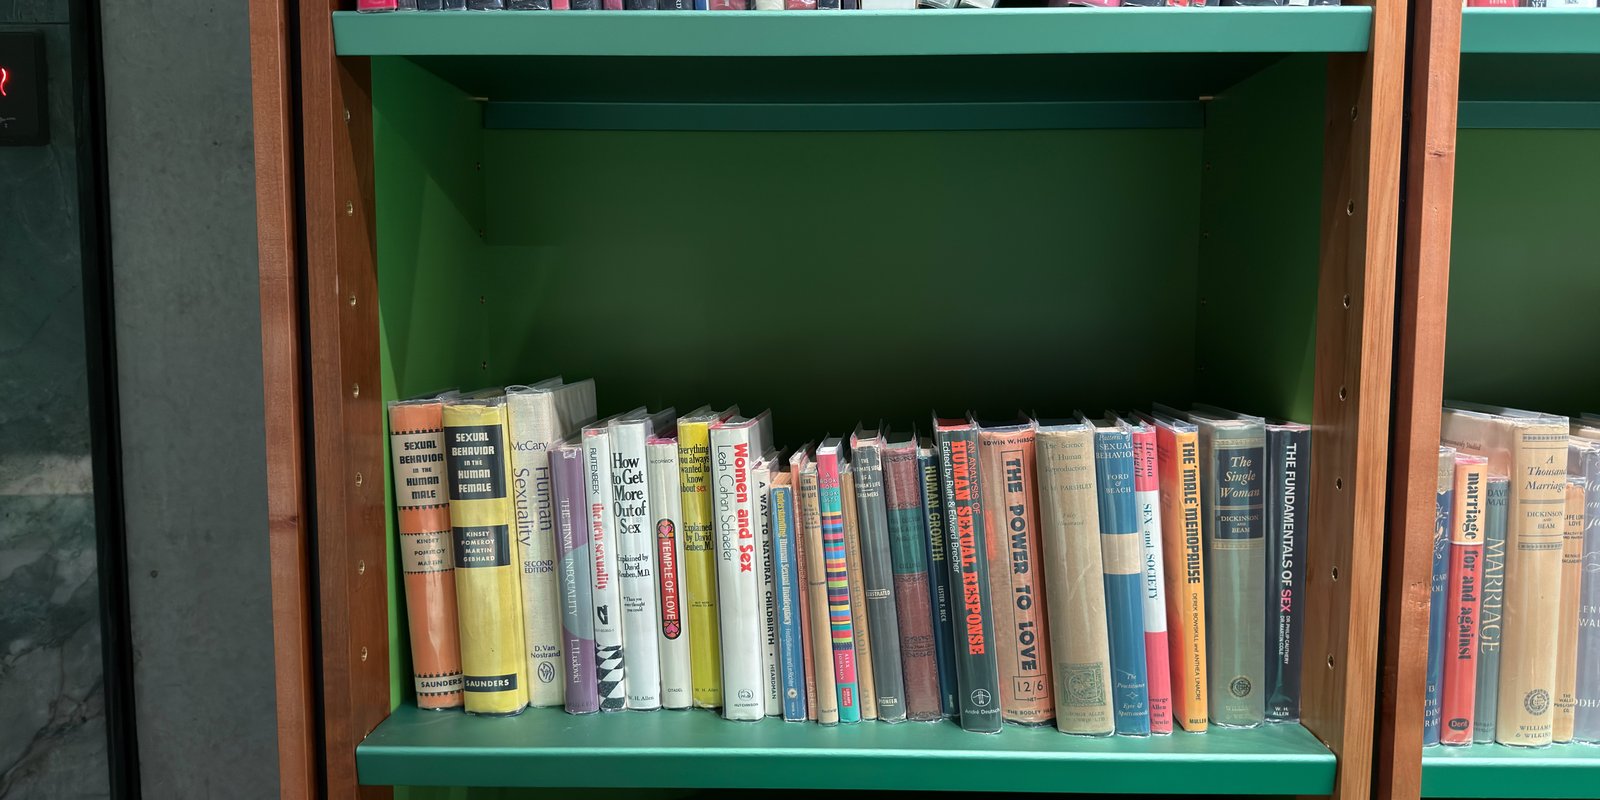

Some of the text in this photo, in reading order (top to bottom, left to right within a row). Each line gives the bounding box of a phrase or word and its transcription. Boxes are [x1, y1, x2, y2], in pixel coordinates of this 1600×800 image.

[404, 440, 437, 450] SEXUAL
[456, 432, 489, 442] SEXUAL
[511, 440, 548, 452] McCary
[399, 453, 444, 464] BEHAVIOR
[452, 446, 495, 456] BEHAVIOR
[612, 453, 640, 468] How
[689, 454, 710, 464] always
[942, 441, 952, 467] Edited
[1134, 441, 1144, 478] Wright
[1146, 442, 1154, 477] Helena
[1183, 442, 1196, 464] THE
[1546, 455, 1554, 464] A
[590, 447, 600, 495] RUITENBEEK
[1230, 456, 1252, 467] The
[406, 476, 439, 486] HUMAN
[458, 469, 491, 480] HUMAN
[612, 469, 644, 484] to Get
[686, 474, 704, 483] know
[944, 468, 953, 478] by
[967, 440, 980, 514] AN ANALYSIS OF
[1225, 470, 1256, 485] Single
[411, 490, 436, 500] MALE
[458, 483, 492, 493] FEMALE
[614, 486, 644, 501] More
[696, 485, 707, 493] sex
[946, 480, 954, 499] Ruth
[1220, 487, 1260, 498] Woman
[514, 467, 534, 546] Sexuality
[536, 466, 552, 531] Human
[613, 500, 646, 517] Out of
[718, 444, 736, 562] Leah Cahan Schaefer
[734, 443, 754, 573] Women and Sex
[760, 494, 768, 517] WAY
[925, 465, 944, 561] HUMAN GROWTH
[620, 518, 642, 534] Sex
[762, 524, 769, 535] TO
[948, 510, 958, 539] Edward
[1280, 443, 1297, 612] THE FUNDAMENTALS OF SEX
[592, 502, 609, 590] the new sexuality
[694, 532, 712, 542] David
[1185, 508, 1200, 584] MENOPAUSE
[560, 498, 578, 616] THE FINAL INEQUALITY
[780, 538, 788, 562] Human
[951, 440, 984, 655] HUMAN SEXUAL RESPONSE
[1143, 504, 1158, 601] SEX and SOCIETY
[642, 554, 648, 562] by
[762, 540, 771, 586] NATURAL
[951, 542, 961, 574] Brecher
[1005, 458, 1036, 670] THE POWER TO LOVE
[1457, 472, 1480, 660] marriage for and against
[638, 568, 650, 577] M.D.
[662, 540, 676, 620] TEMPLE OF LOVE
[781, 564, 790, 585] Sexual
[782, 586, 792, 626] Inadequacy
[1481, 538, 1505, 655] MARRIAGE
[765, 590, 775, 645] CHILDBIRTH
[856, 629, 867, 656] HOW
[421, 678, 462, 688] SAUNDERS
[465, 678, 510, 687] SAUNDERS
[1018, 680, 1044, 695] 12/6
